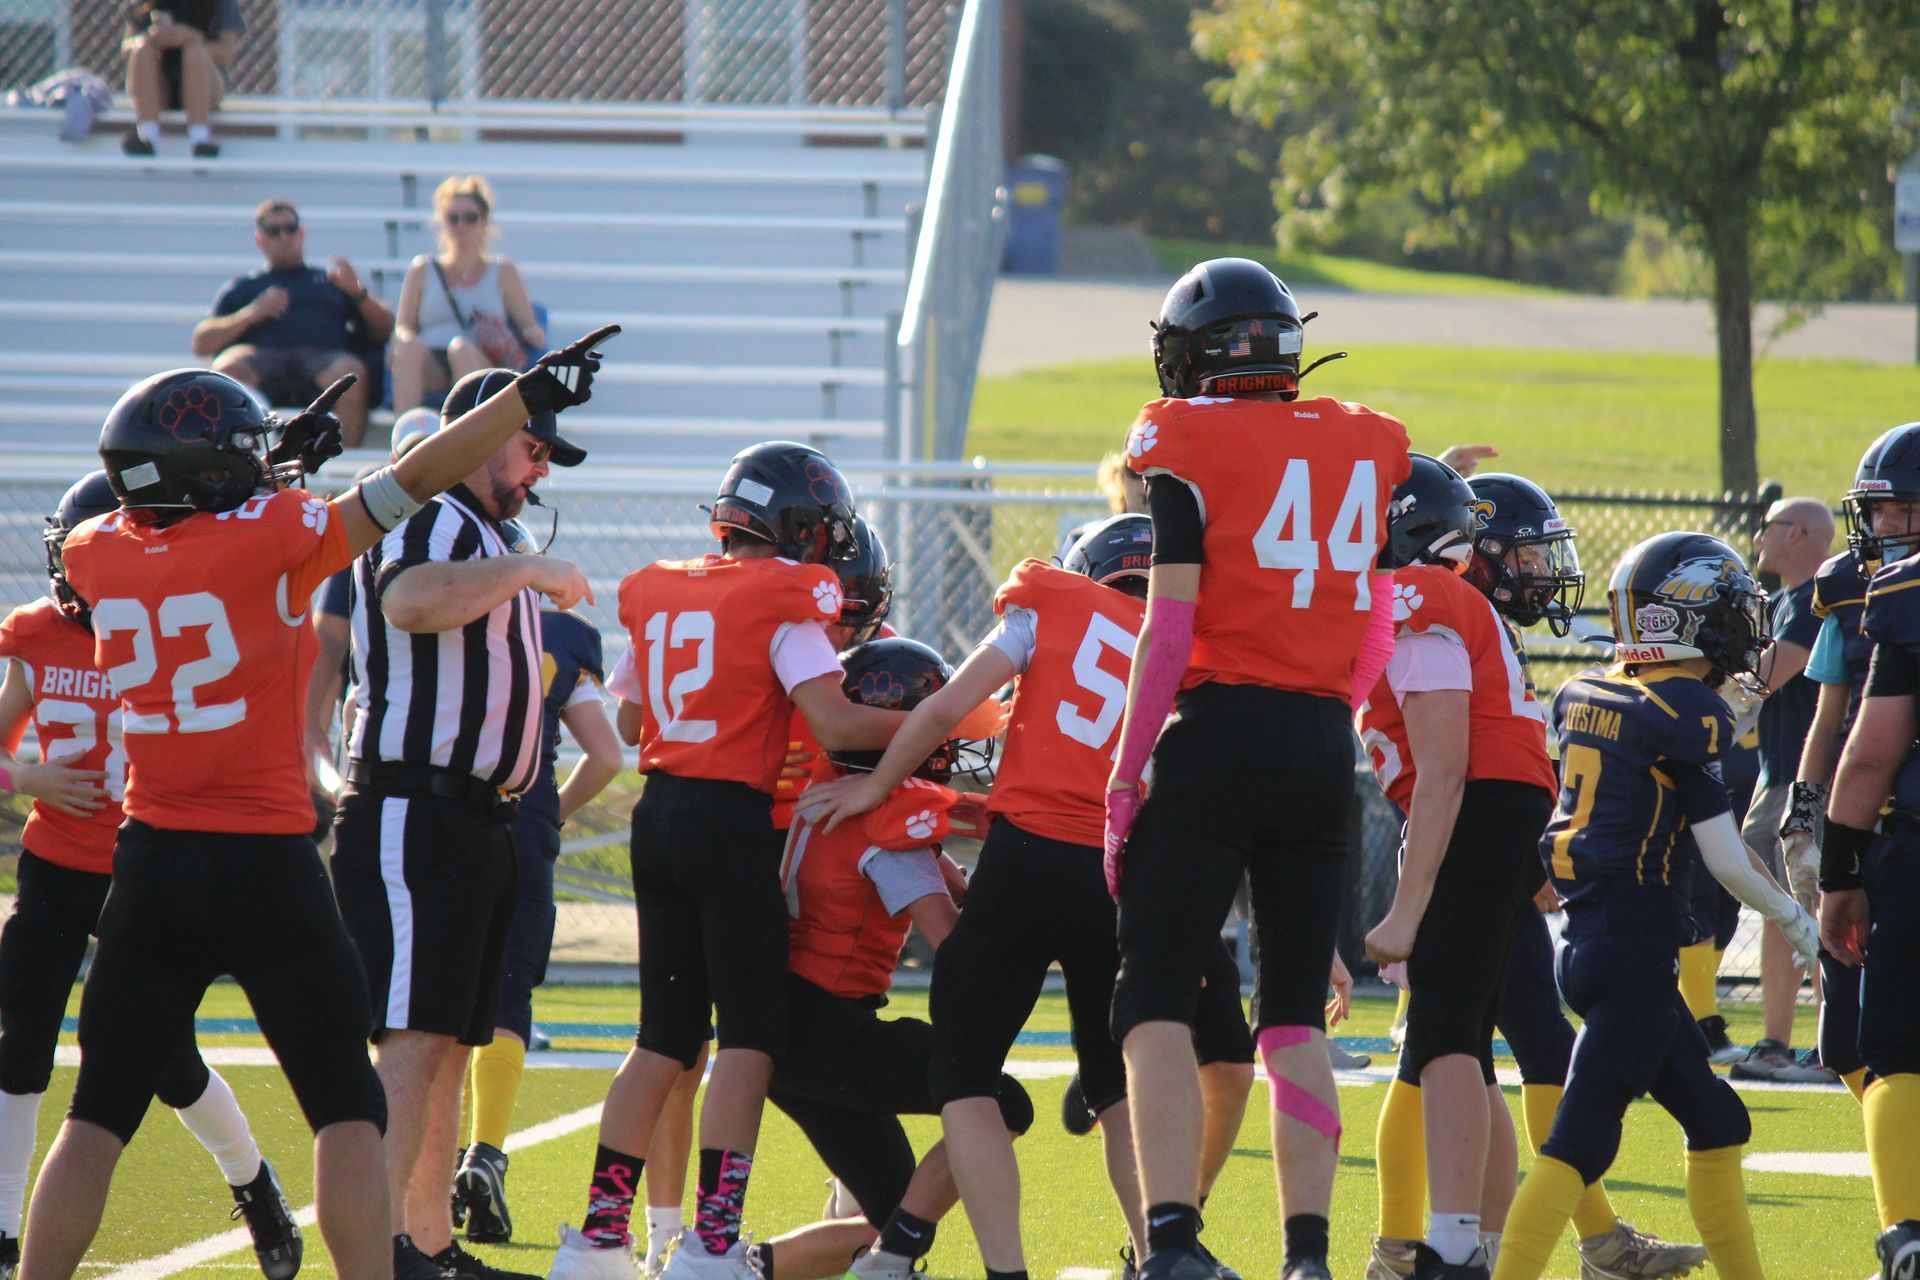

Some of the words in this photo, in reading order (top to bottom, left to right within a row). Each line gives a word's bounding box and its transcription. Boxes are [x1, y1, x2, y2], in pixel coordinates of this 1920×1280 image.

[1216, 375, 1293, 393] BRIGHTON
[1252, 458, 1378, 611] 44
[91, 591, 247, 735] 22
[644, 610, 717, 743] 12
[1056, 611, 1139, 763] 5
[1701, 715, 1719, 753] 7
[1551, 743, 1602, 880] 7
